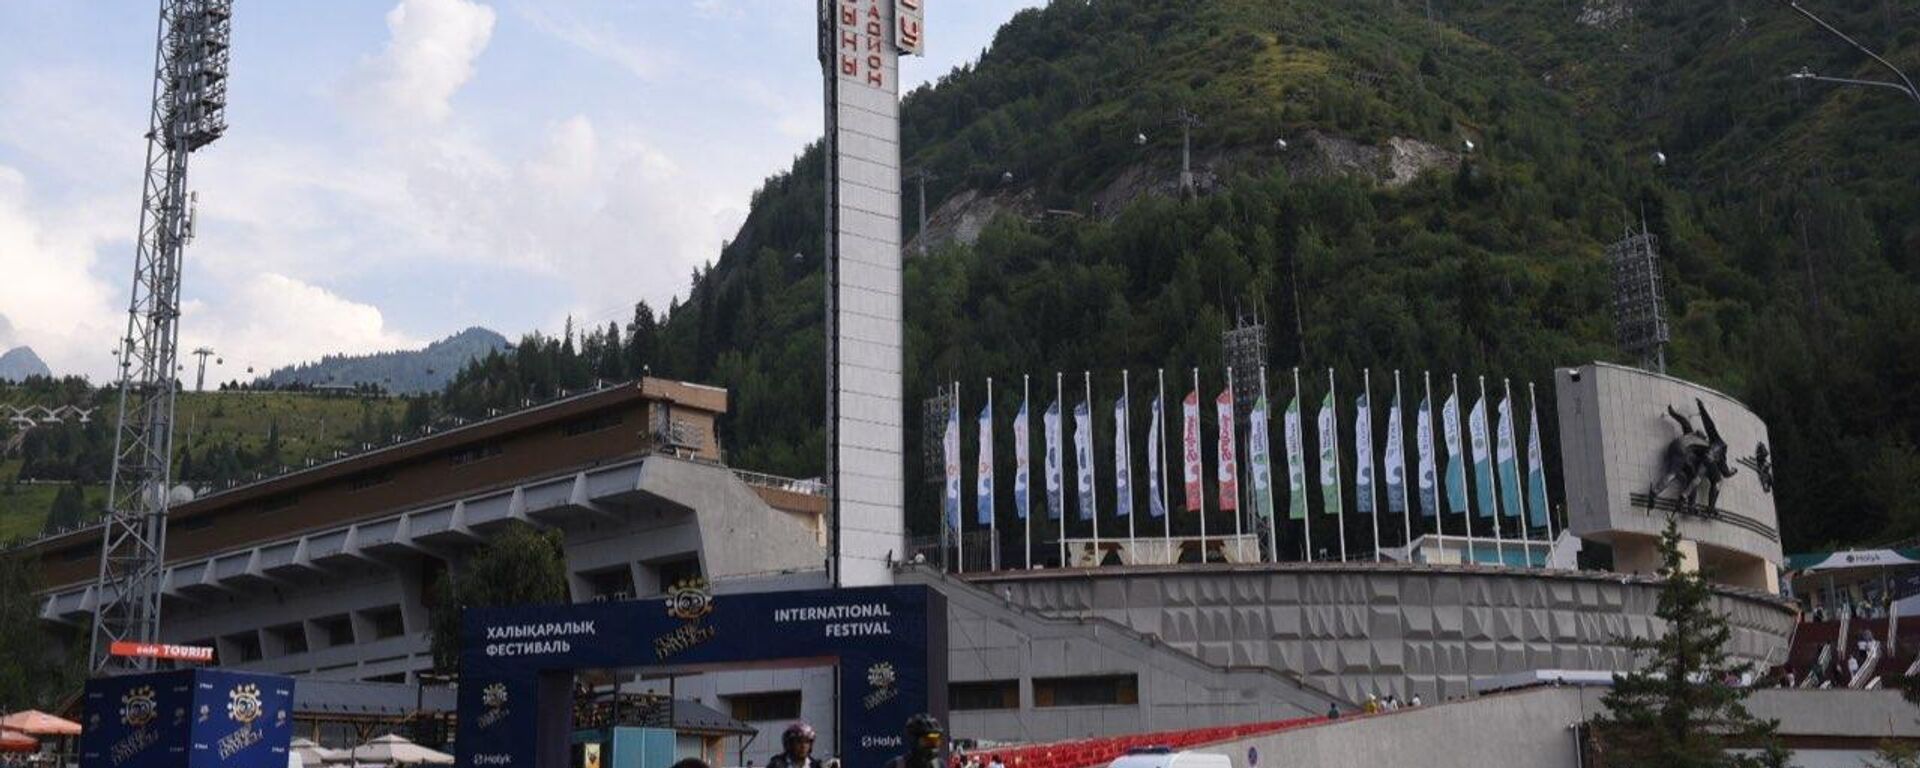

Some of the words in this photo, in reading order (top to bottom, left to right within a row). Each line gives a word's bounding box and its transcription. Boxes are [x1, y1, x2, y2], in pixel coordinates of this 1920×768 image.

[841, 0, 857, 76] ЫНЫ
[774, 603, 891, 622] INTERNATIONAL
[487, 620, 596, 639] ХАЛЫҚАРАЛЫҚ
[825, 621, 891, 637] FESTIVAL
[162, 644, 214, 659] TOURIST
[486, 640, 571, 656] ФЕСТИВАЛЬ
